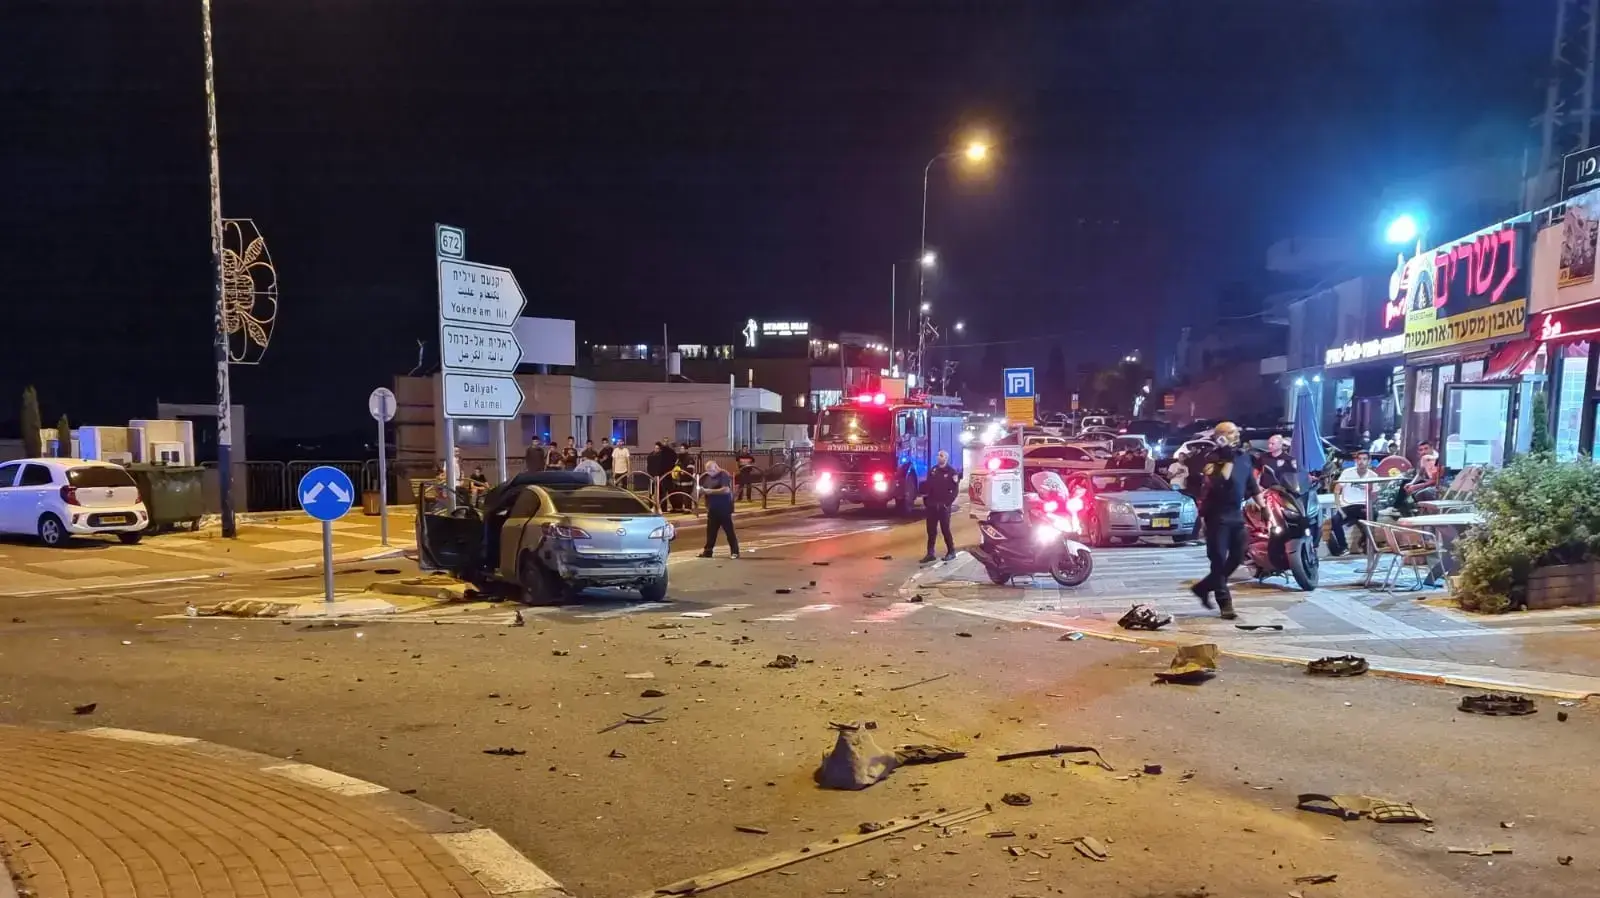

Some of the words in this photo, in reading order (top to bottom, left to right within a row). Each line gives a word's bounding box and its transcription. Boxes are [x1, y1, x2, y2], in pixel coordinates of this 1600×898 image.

[442, 235, 459, 249] 672
[453, 269, 476, 283] עילית
[480, 274, 504, 288] יקנעם
[451, 302, 492, 316] Yokne'am
[496, 307, 508, 319] Ilit
[1487, 306, 1525, 338] טאבון
[447, 331, 485, 347] אל-כרמל
[488, 336, 512, 350] דאלית
[463, 382, 499, 395] Daliyat-
[463, 400, 471, 408] al
[474, 399, 502, 409] Karmel
